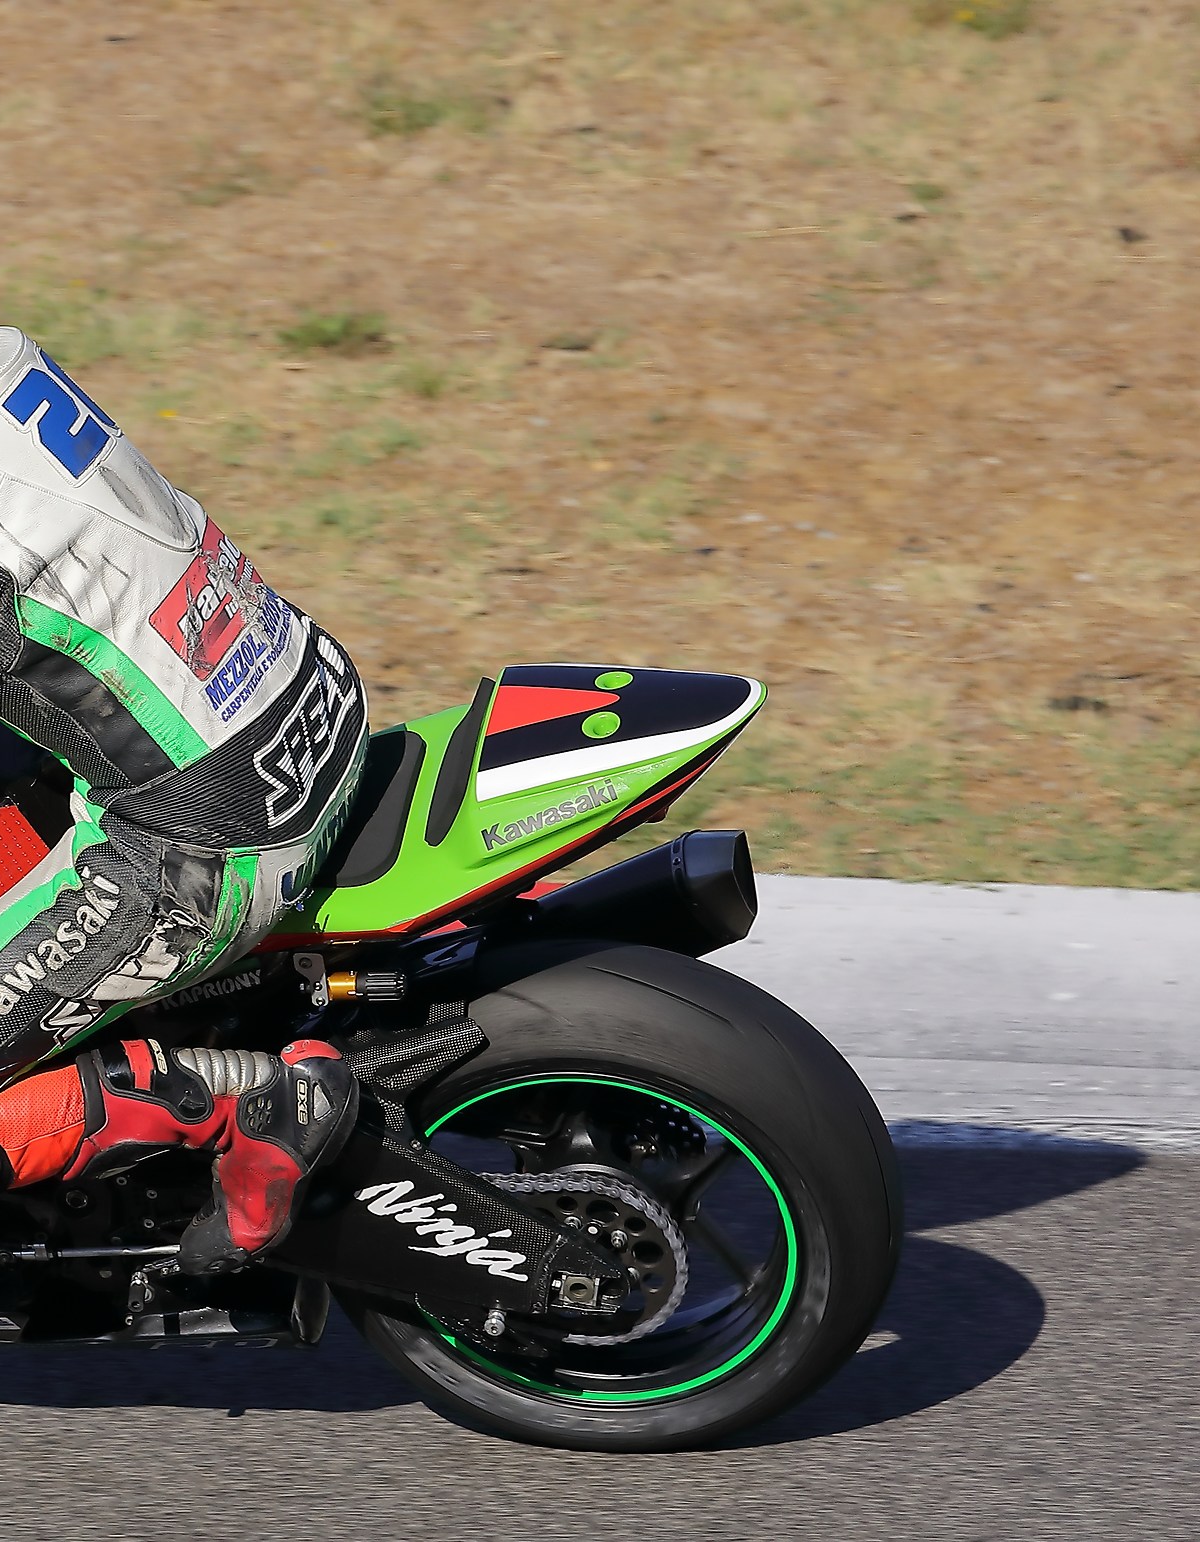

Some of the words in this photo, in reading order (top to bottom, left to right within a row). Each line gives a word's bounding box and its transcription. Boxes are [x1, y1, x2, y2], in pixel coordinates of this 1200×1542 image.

[2, 348, 117, 479] 2
[480, 778, 618, 851] Kawasaki
[159, 968, 262, 1012] KAPRIONY
[354, 1180, 529, 1282] Ninja
